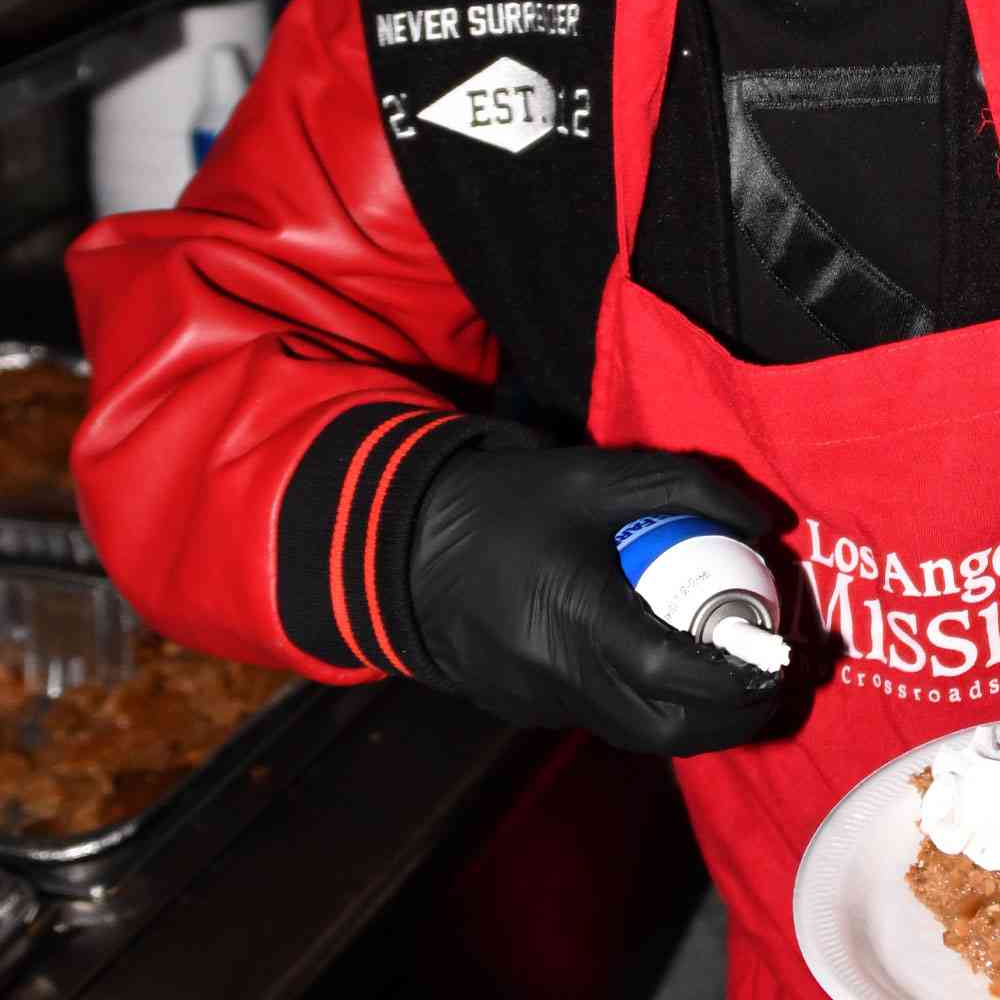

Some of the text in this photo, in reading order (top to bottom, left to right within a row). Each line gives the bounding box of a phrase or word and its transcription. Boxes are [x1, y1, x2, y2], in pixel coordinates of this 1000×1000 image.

[376, 7, 461, 47] NEVER
[467, 85, 548, 128] EST.
[805, 518, 879, 580] Los
[841, 663, 1000, 703] Crossroads
